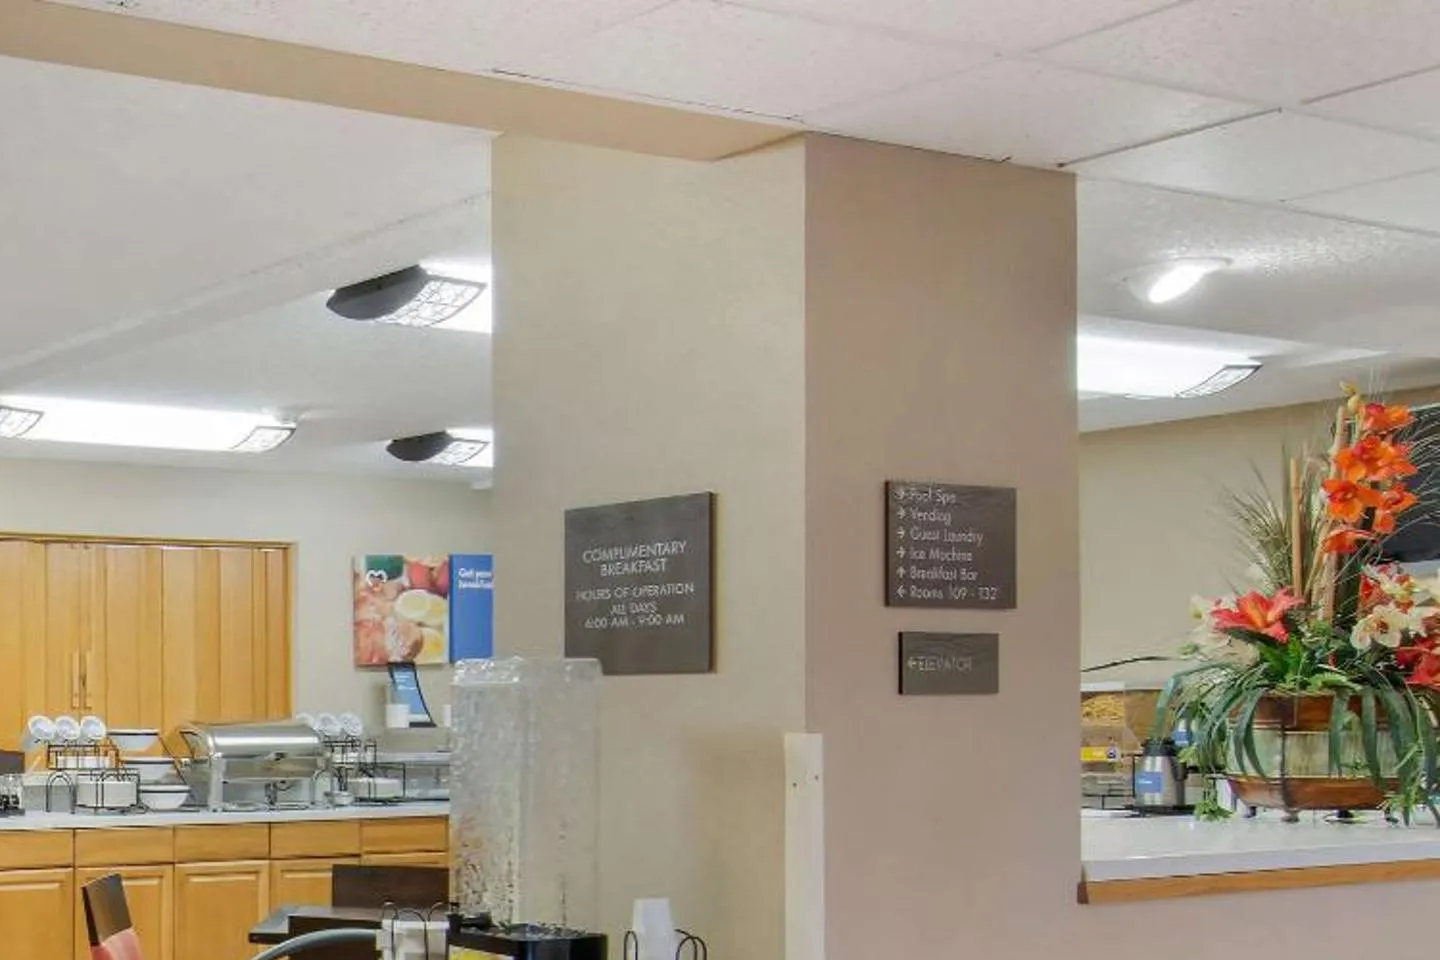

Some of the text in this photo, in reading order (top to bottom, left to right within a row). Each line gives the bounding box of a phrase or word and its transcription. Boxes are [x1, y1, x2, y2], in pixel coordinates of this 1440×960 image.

[910, 507, 952, 526] Vending
[910, 526, 984, 547] Guest Laundry
[582, 540, 687, 564] COMPLIMENTARY
[600, 558, 667, 577] BREAKFAST
[910, 566, 978, 581] Breakfast Bar
[575, 582, 695, 602] HOURS OF OPERATION
[910, 585, 944, 600] Rooms
[610, 601, 657, 616] ALL DAYS
[610, 615, 629, 628] AM
[665, 613, 685, 626] AM
[918, 655, 972, 671] ELEVATOR
